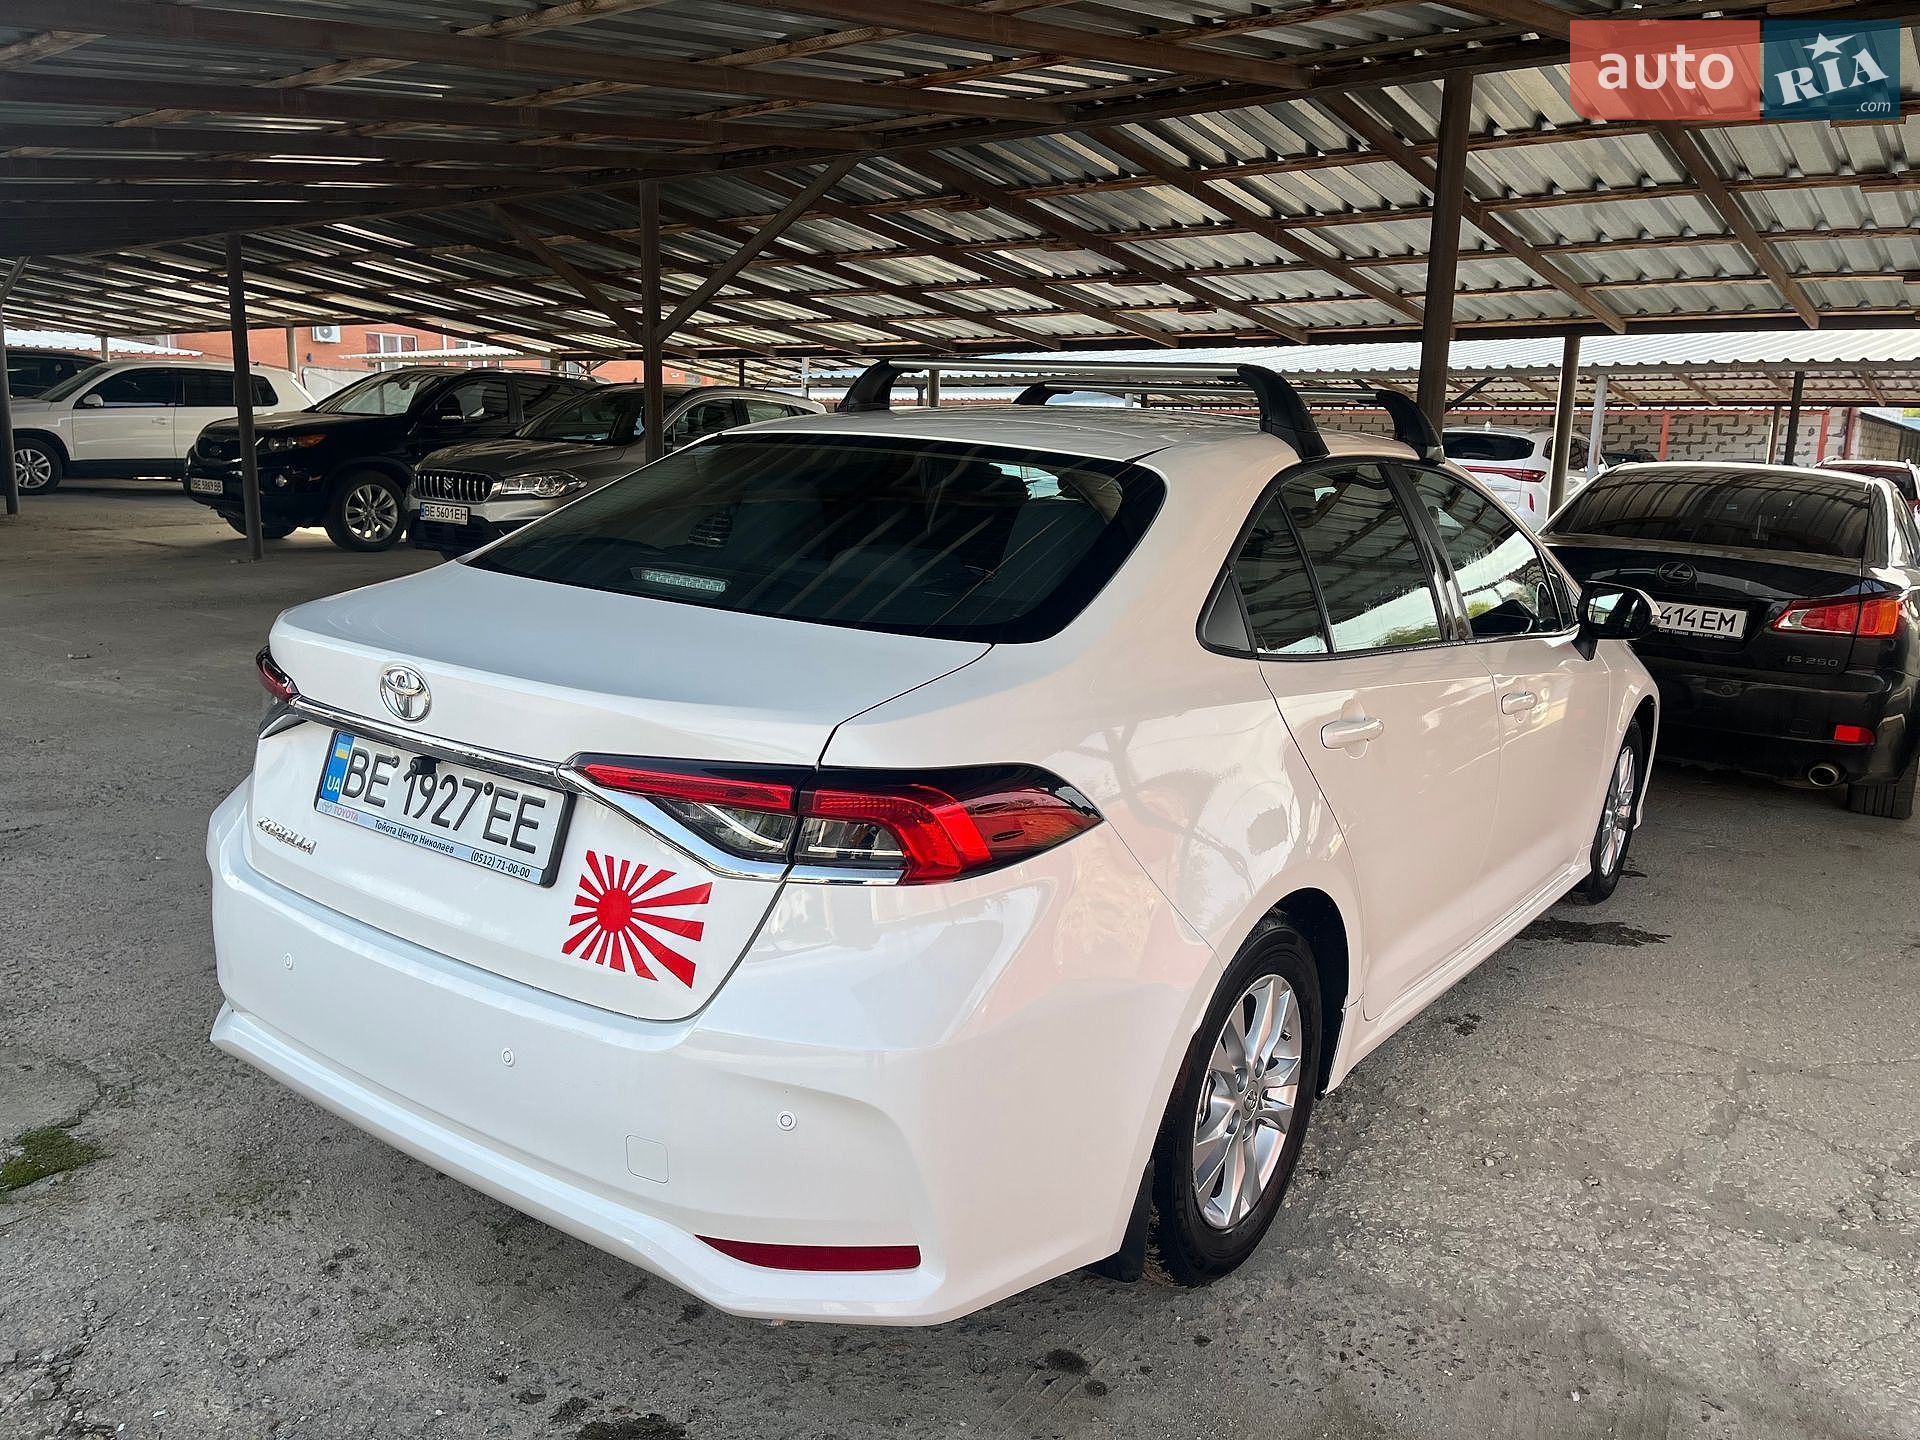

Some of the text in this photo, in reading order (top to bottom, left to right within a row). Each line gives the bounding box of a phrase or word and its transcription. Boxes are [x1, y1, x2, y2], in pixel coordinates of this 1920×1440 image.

[1658, 606, 1697, 628] 414
[1806, 657, 1839, 667] 250
[326, 775, 341, 793] UA
[342, 746, 547, 854] BE 1927 EE
[334, 806, 359, 822] TOYOTA
[374, 819, 454, 854] Тойота Центр Николаев
[471, 850, 531, 878] (0512) 71-00-00
